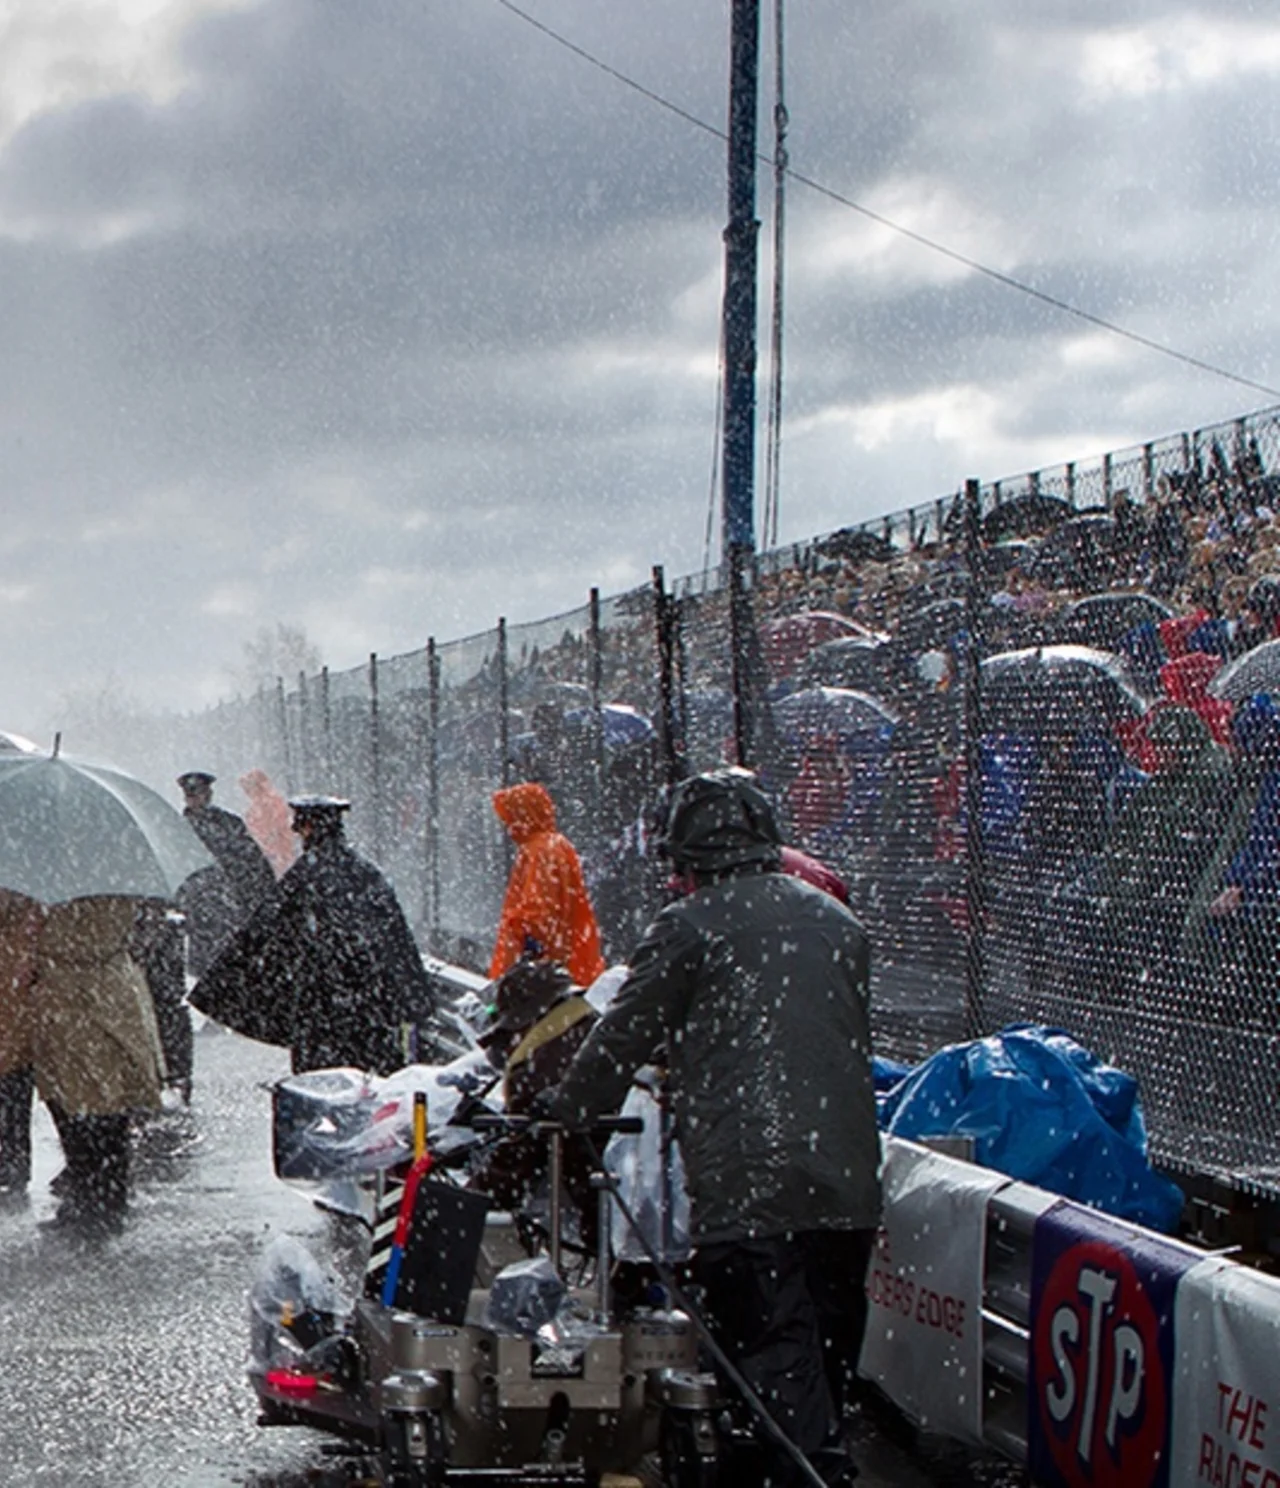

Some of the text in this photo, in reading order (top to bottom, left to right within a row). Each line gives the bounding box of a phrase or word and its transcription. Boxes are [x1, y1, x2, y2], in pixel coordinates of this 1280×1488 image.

[864, 1270, 966, 1338] CERS EDGE
[1045, 1267, 1145, 1462] STP
[1217, 1381, 1268, 1450] THE
